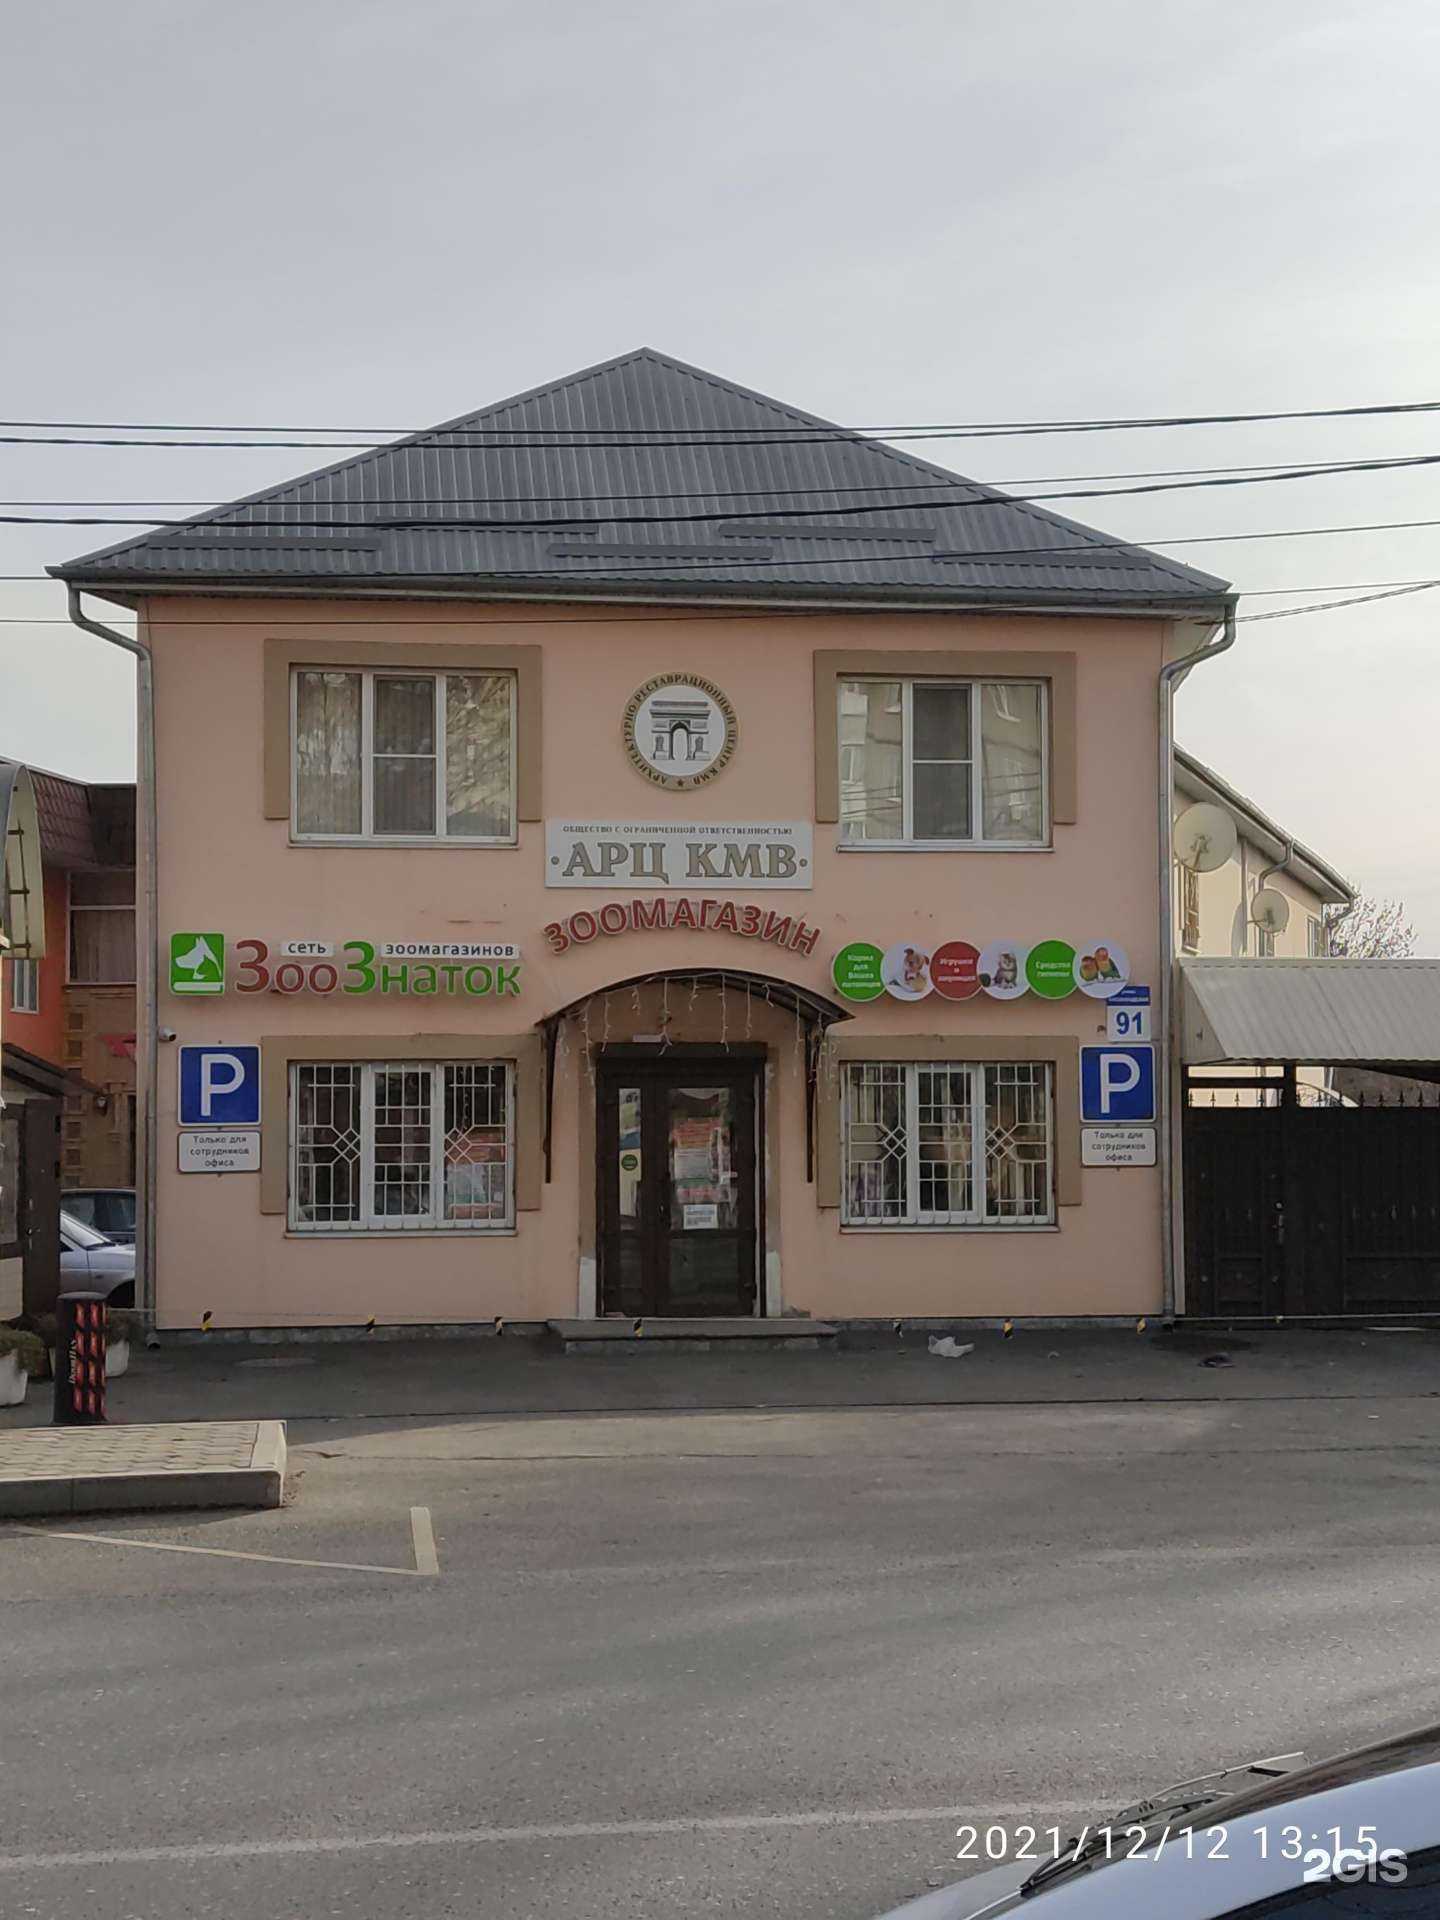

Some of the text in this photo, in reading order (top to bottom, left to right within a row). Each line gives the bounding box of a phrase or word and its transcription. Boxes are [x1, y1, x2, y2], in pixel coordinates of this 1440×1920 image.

[563, 825, 612, 834] ОБЩЕСТВО
[615, 826, 620, 834] С
[624, 826, 696, 835] ОГРАНИЧЕННОЙ
[562, 841, 797, 885] АРЦ КМВ
[543, 898, 821, 954] ЗООМАГАЗИН
[287, 942, 514, 957] сеть зоомагазинов
[1116, 1011, 1144, 1035] 91
[200, 1053, 245, 1117] P
[1100, 1053, 1141, 1114] P
[1094, 1131, 1125, 1139] Только
[190, 1148, 249, 1157] сотрудников
[1091, 1143, 1146, 1151] сотрудников
[204, 1159, 234, 1167] офиса
[1105, 1154, 1133, 1162] офиса
